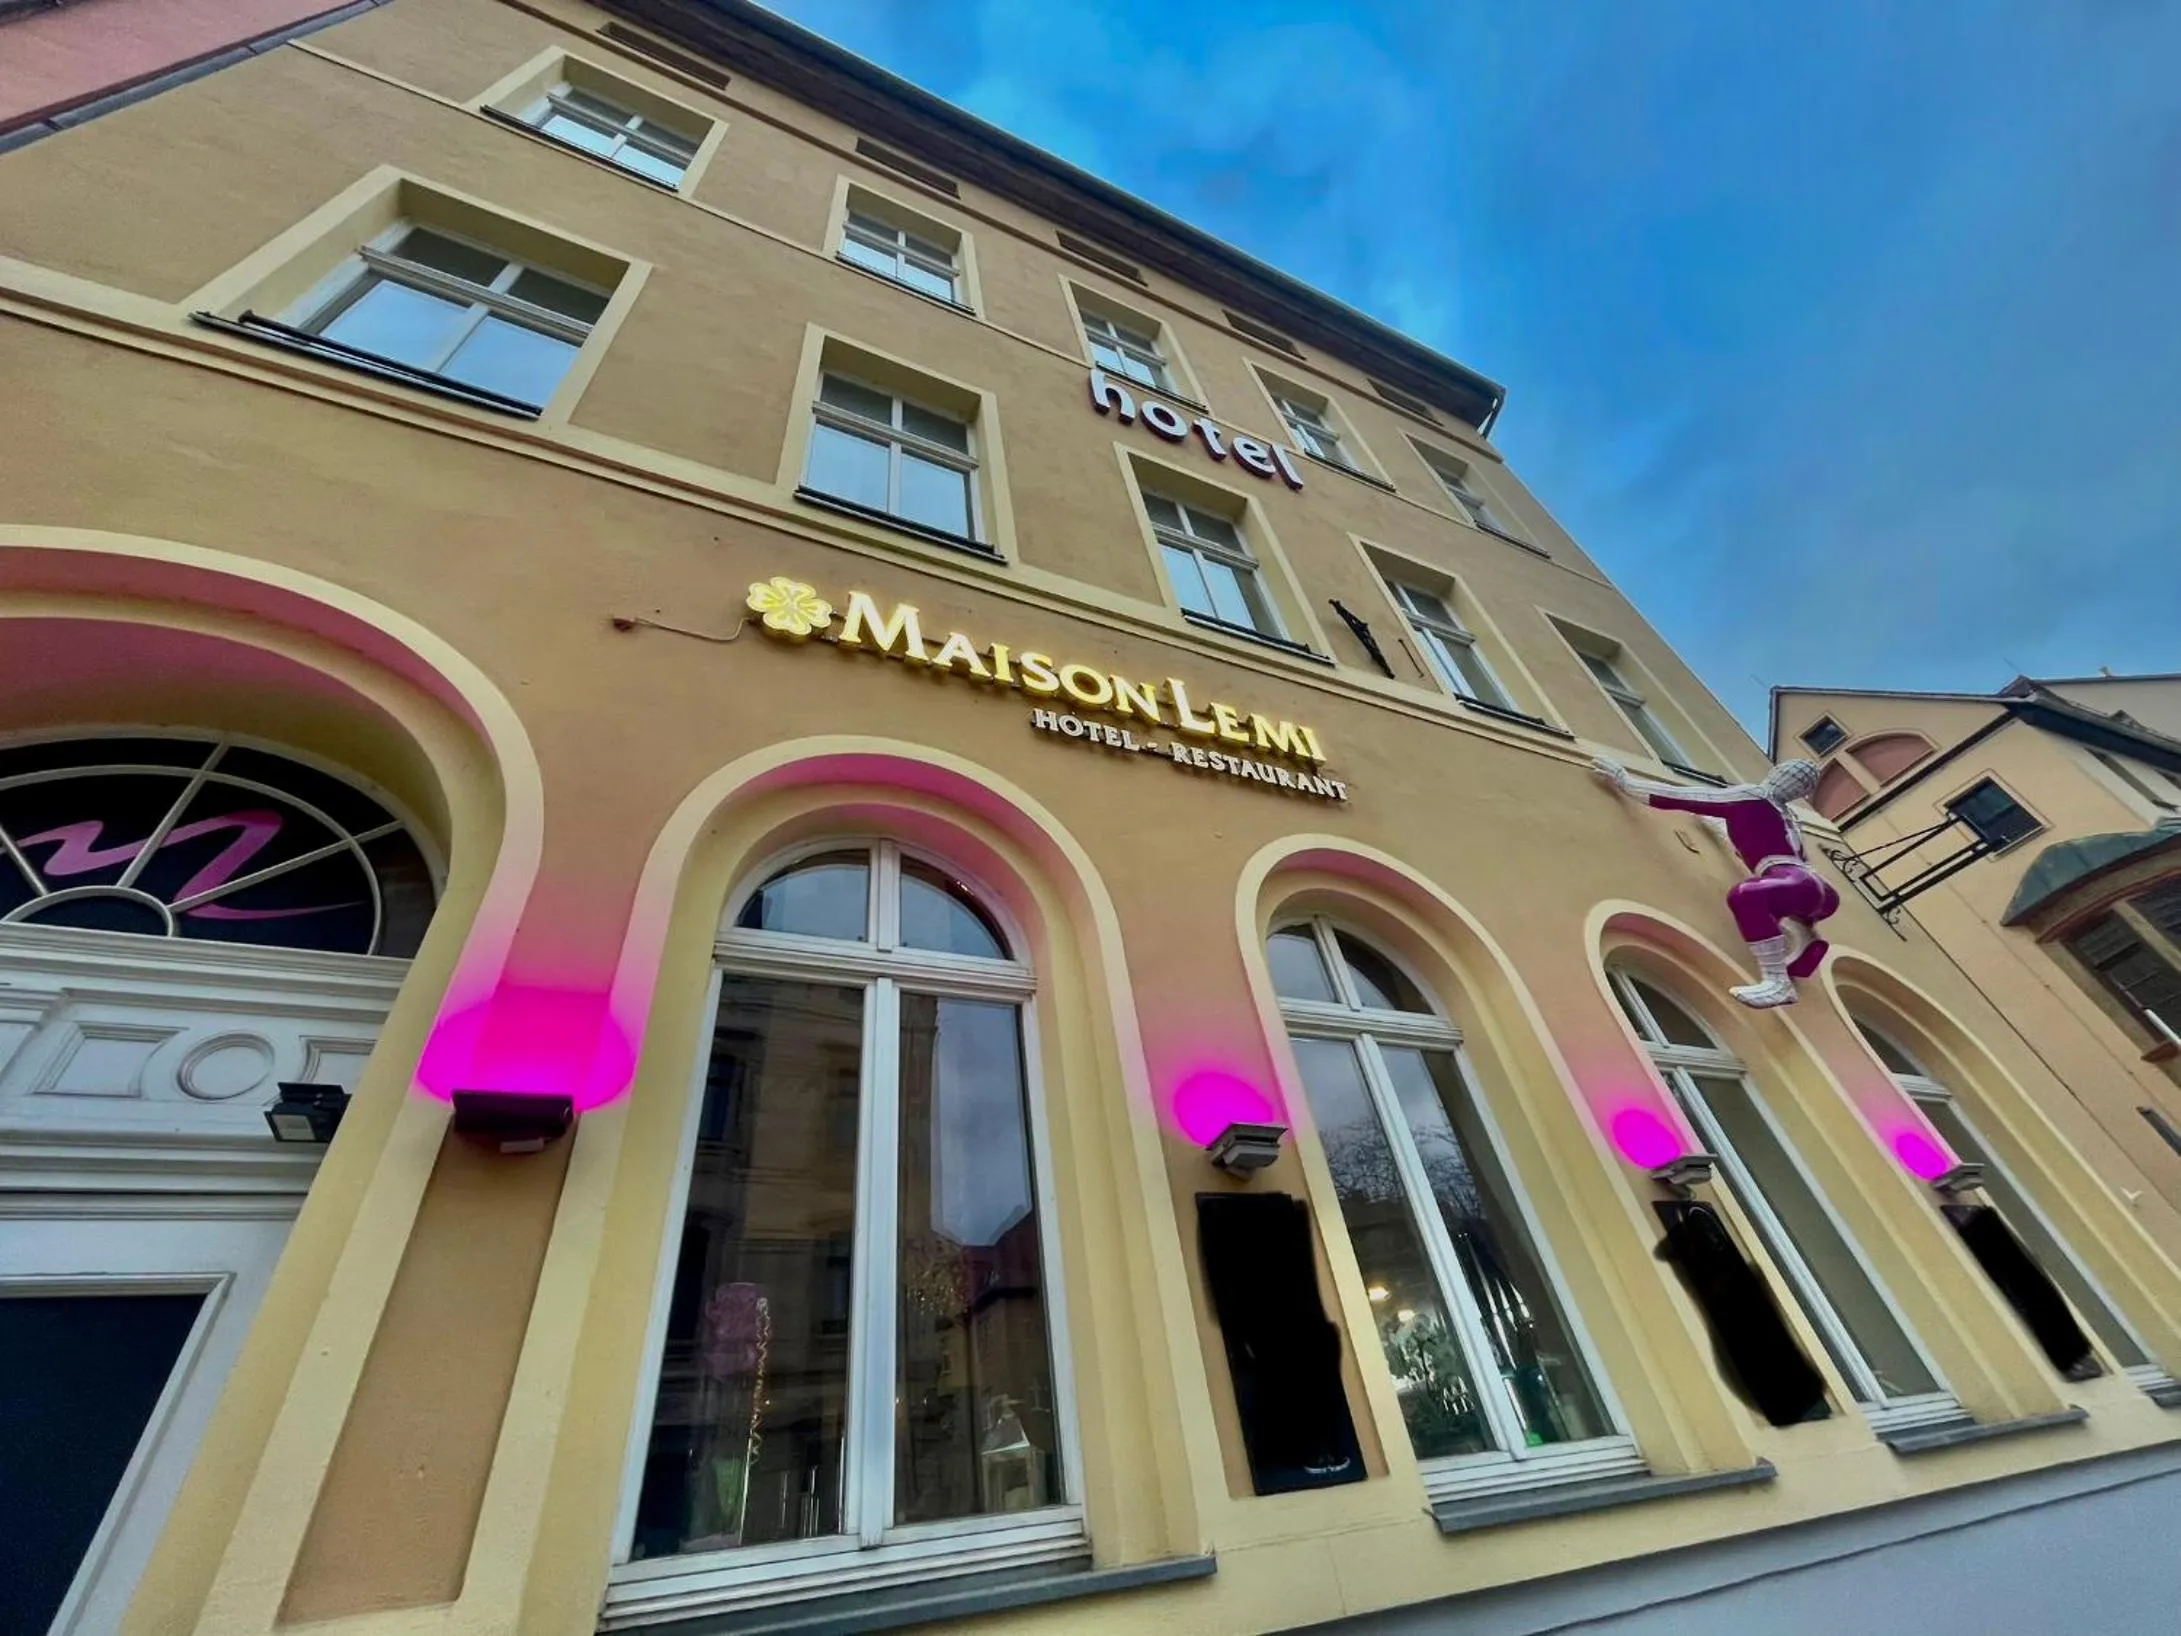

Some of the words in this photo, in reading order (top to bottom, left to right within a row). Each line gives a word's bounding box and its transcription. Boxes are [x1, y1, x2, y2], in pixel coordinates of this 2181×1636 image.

[1089, 368, 1304, 491] hotel
[1032, 707, 1140, 752] HOTEL
[1169, 740, 1349, 801] RESTAURANT
